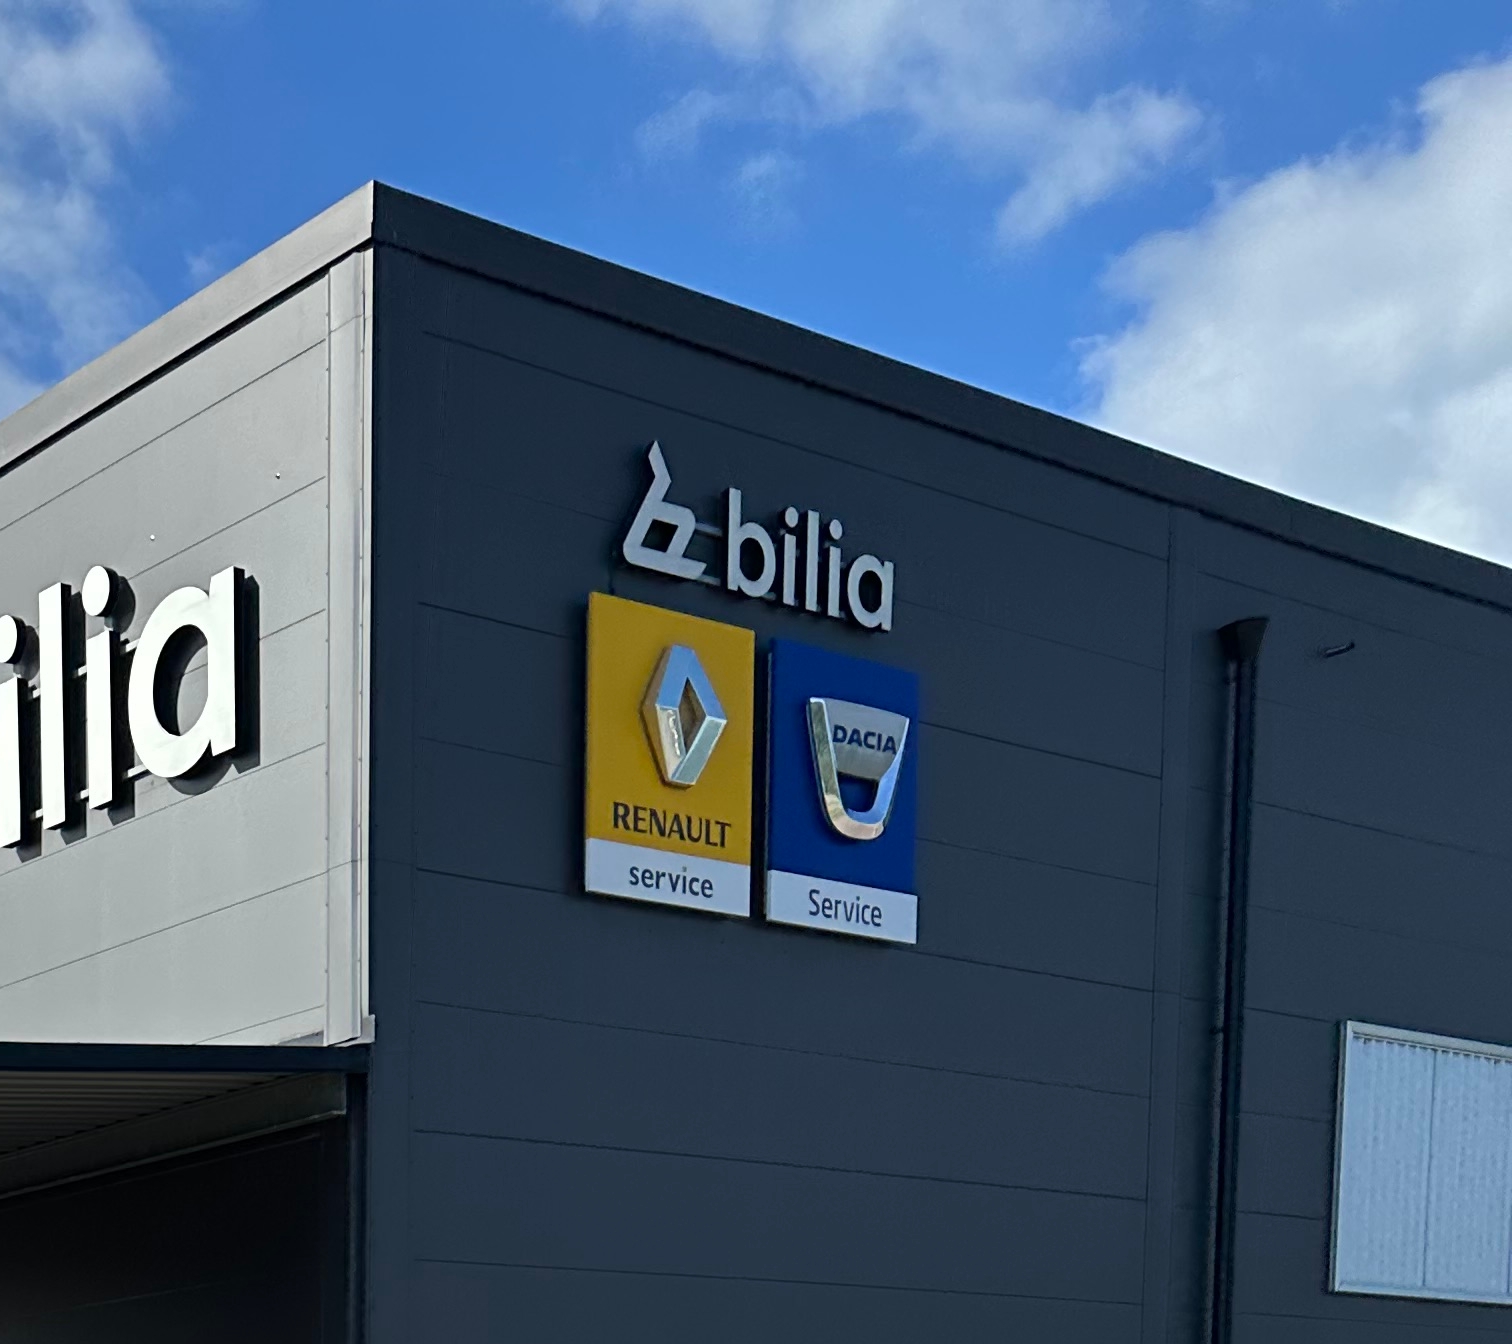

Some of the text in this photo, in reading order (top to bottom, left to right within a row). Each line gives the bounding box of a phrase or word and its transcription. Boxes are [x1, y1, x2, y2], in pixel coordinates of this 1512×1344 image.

[728, 487, 895, 631] bilia
[832, 723, 898, 756] DACIA
[612, 801, 732, 850] RENAULT
[628, 864, 714, 900] service
[807, 888, 883, 928] Service
